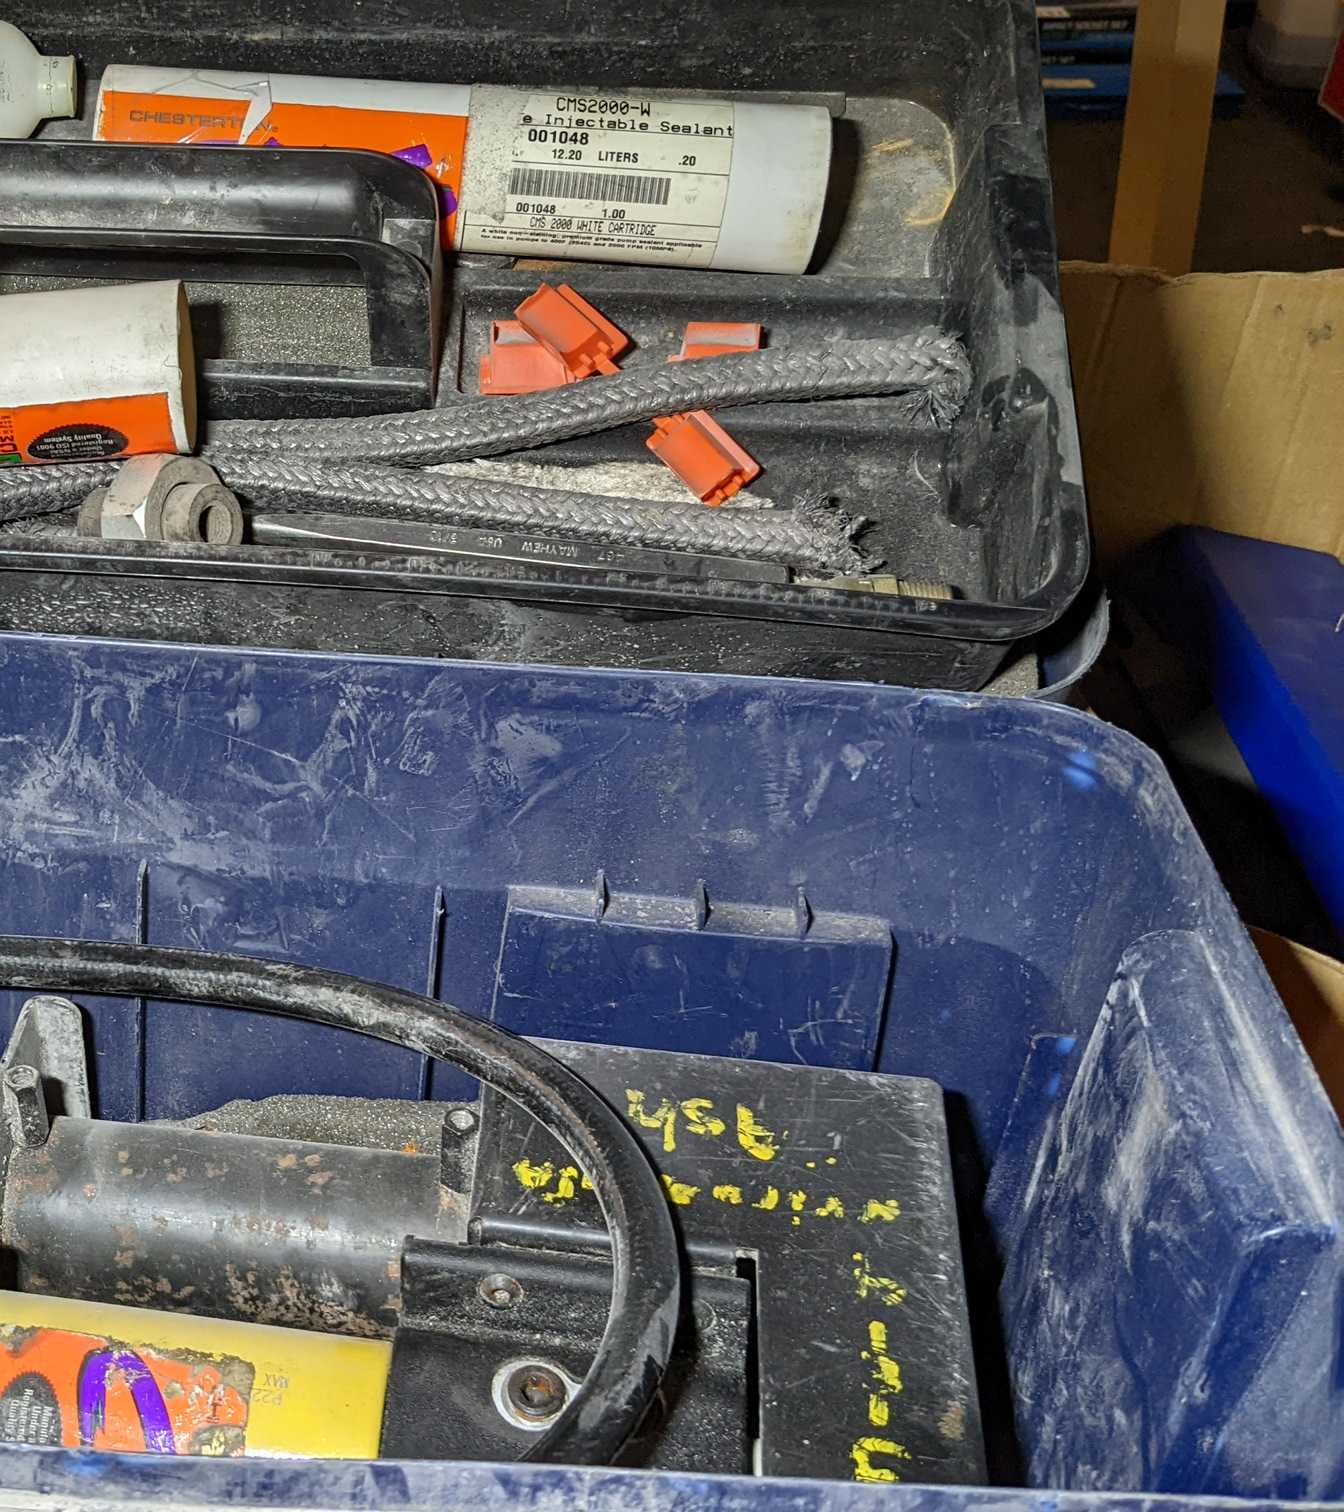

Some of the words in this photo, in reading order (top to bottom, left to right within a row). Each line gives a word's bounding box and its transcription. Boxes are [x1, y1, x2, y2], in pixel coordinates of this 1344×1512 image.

[556, 97, 650, 117] CMS2000-W
[129, 109, 273, 132] CHESTERTN
[545, 113, 649, 131] Injectable
[660, 121, 733, 137] Sealant
[527, 128, 590, 145] 001048
[551, 148, 582, 161] 12.20
[598, 151, 639, 164] LITERS
[678, 155, 697, 167] .20
[515, 202, 556, 215] 001048
[601, 208, 626, 219] 1.00
[529, 216, 546, 229] CMS
[551, 217, 572, 231] 2000
[576, 220, 604, 233] WHITE
[608, 222, 656, 236] CARTRIDGE
